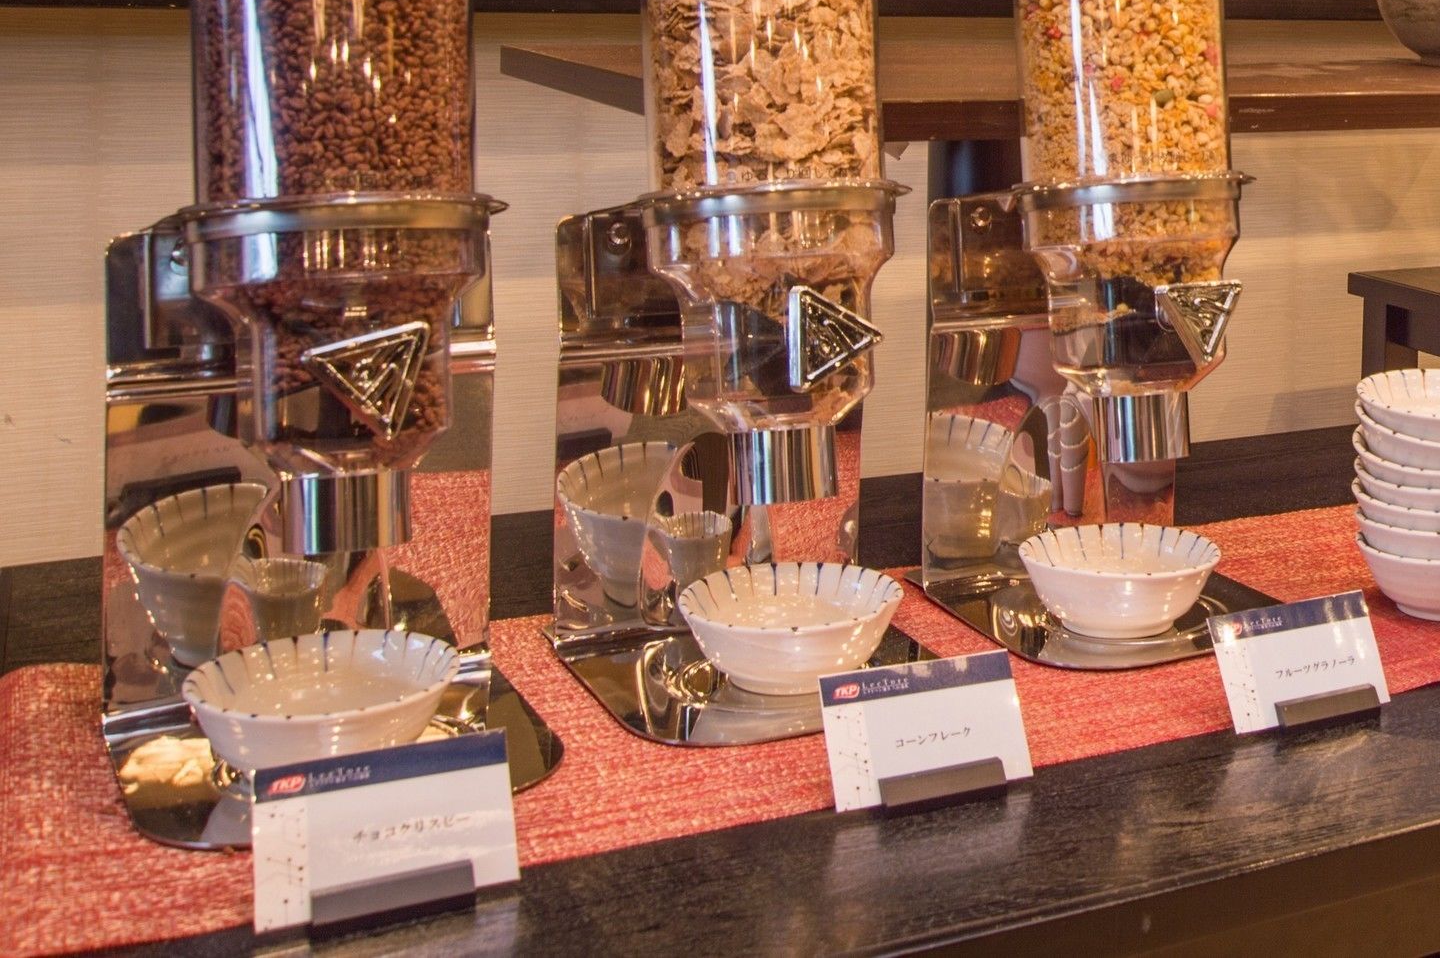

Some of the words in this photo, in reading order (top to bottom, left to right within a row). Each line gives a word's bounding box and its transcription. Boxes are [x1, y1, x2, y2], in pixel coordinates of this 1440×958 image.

[1276, 656, 1356, 679] フルーツグラノーラ
[832, 682, 860, 700] TKP
[895, 726, 971, 749] コーンフレーク
[353, 815, 471, 843] チョコクリスピー
